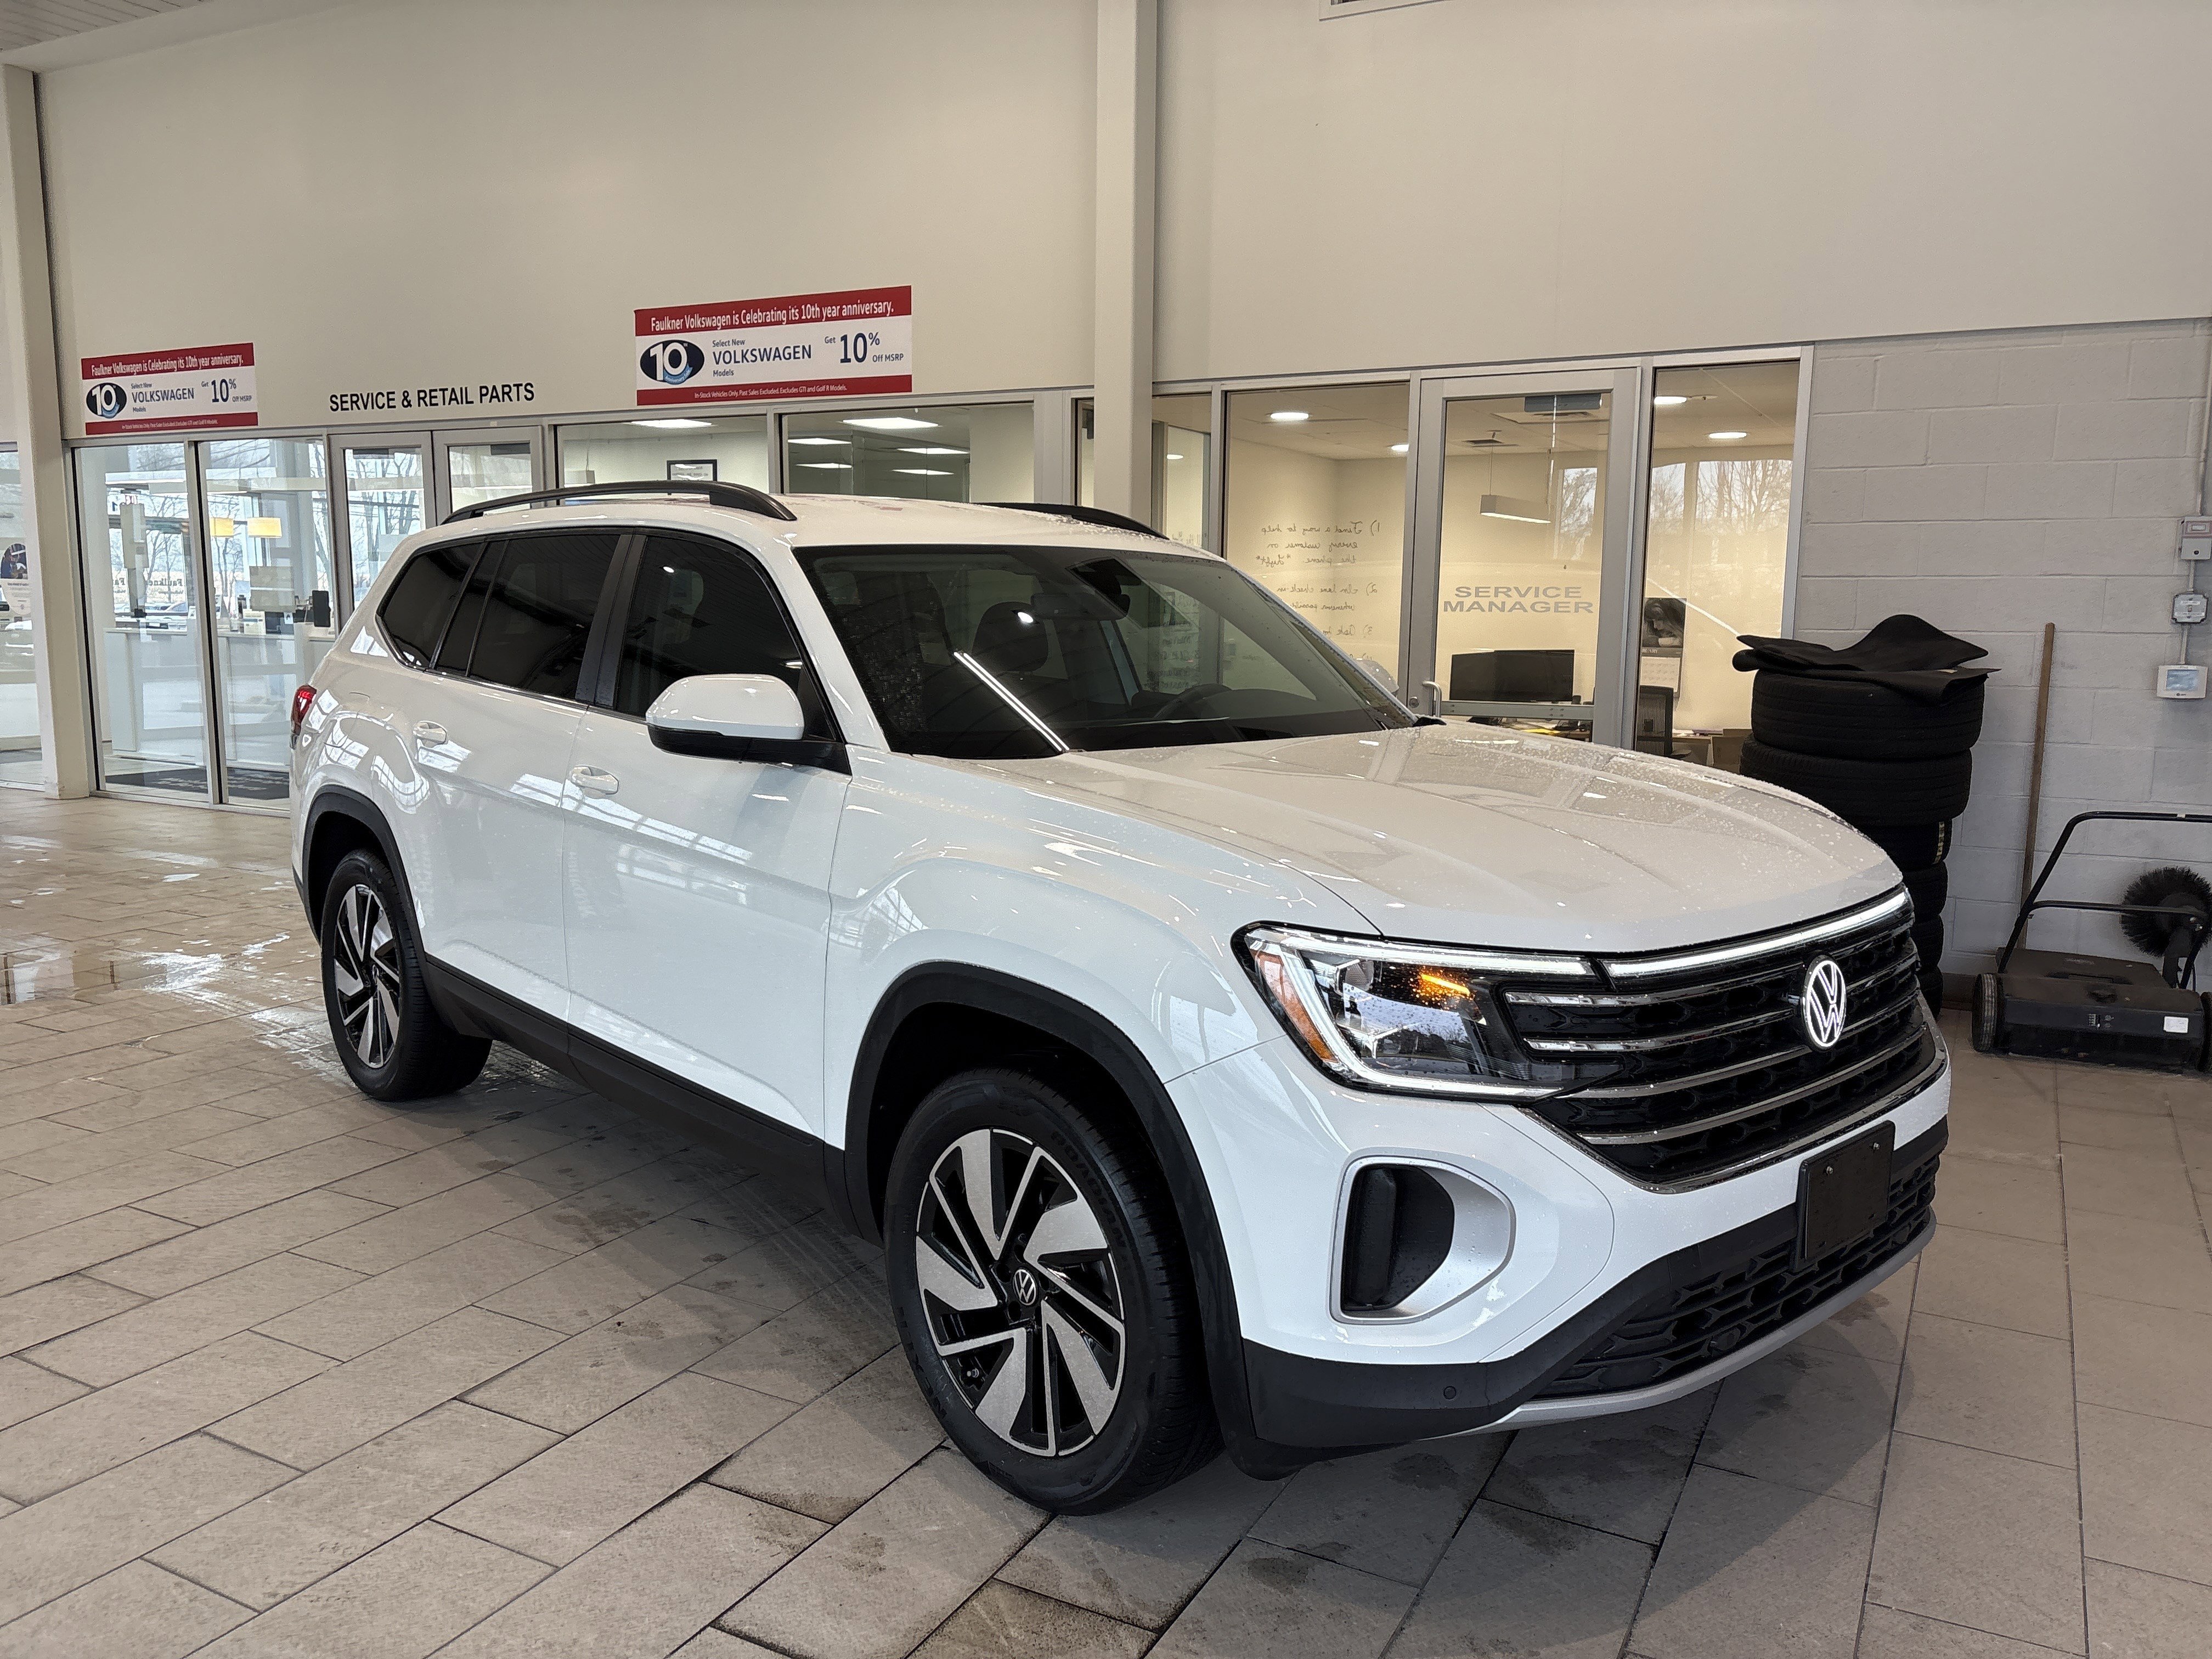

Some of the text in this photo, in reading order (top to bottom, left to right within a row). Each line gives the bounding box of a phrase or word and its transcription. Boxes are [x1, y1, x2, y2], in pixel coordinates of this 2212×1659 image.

[651, 316, 684, 331] Faulkner
[685, 313, 731, 330] Volkswagen
[733, 310, 739, 325] is
[741, 307, 787, 325] Celebrating
[802, 303, 820, 319] 10th
[822, 306, 840, 321] year
[842, 300, 894, 316] anniversary.
[650, 342, 687, 380] 10
[713, 345, 811, 365] VOLKSWAGEN
[884, 353, 904, 362] MSRP
[91, 364, 112, 376] Faulkner
[112, 362, 142, 375] Volkswagen
[143, 360, 147, 371] is
[148, 358, 177, 371] Celebrating
[185, 356, 198, 368] 10th
[198, 357, 210, 369] year
[713, 369, 734, 377] Models
[92, 385, 116, 415] 10
[132, 388, 194, 403] VOLKSWAGEN
[330, 382, 534, 411] SERVICE & RETAIL PARTS
[1454, 586, 1582, 599] SERVICE
[1443, 601, 1594, 613] MANAGER
